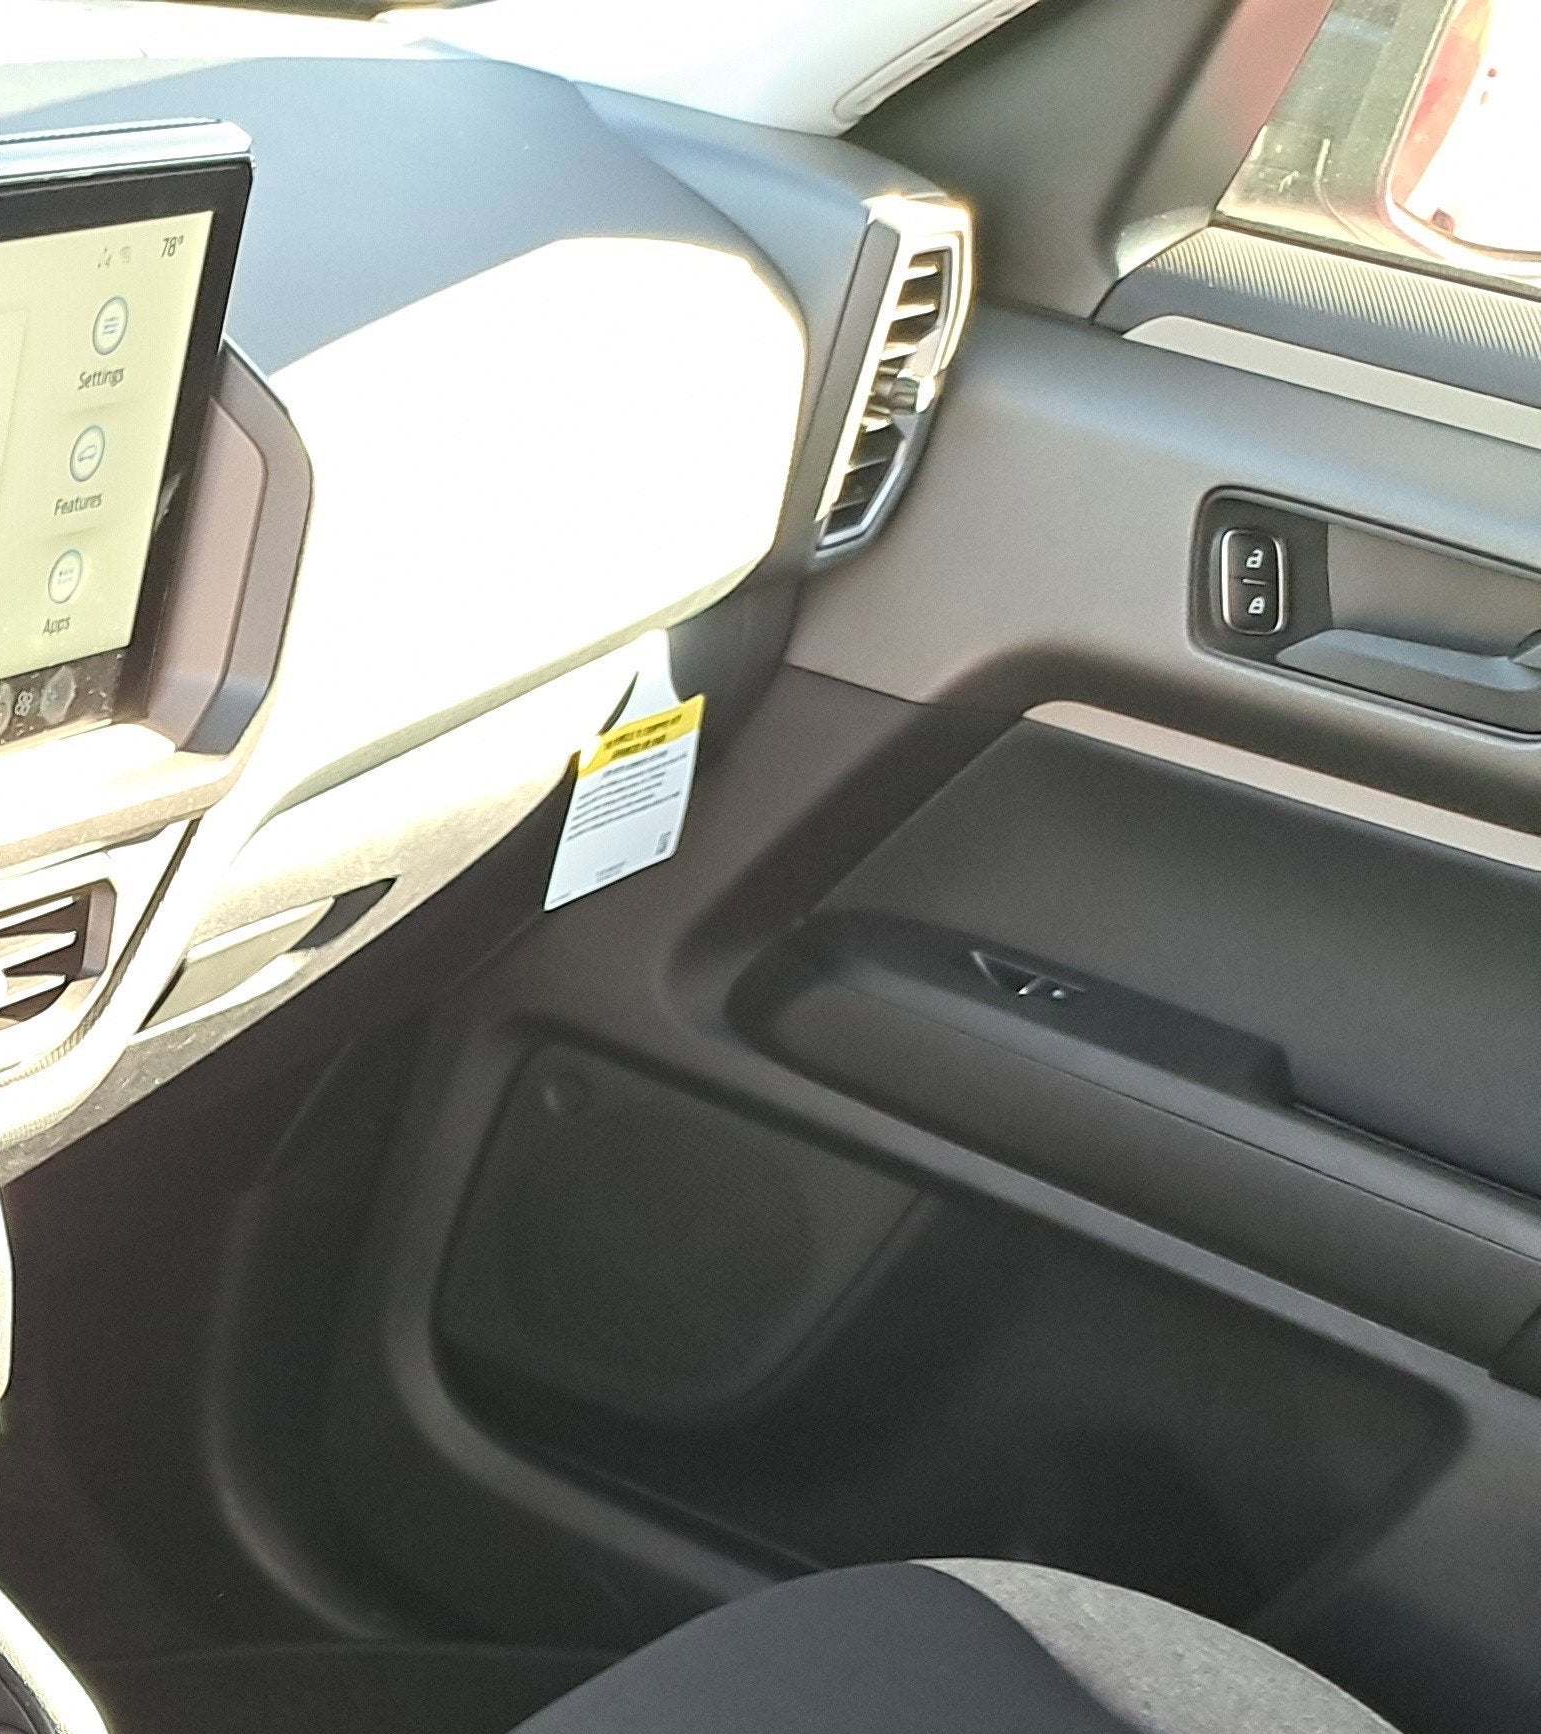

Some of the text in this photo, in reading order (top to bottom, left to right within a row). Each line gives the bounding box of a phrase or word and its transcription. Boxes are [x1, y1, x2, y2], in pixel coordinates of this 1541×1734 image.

[76, 365, 125, 391] Settings
[53, 491, 103, 517] Features
[42, 616, 71, 635] Apps
